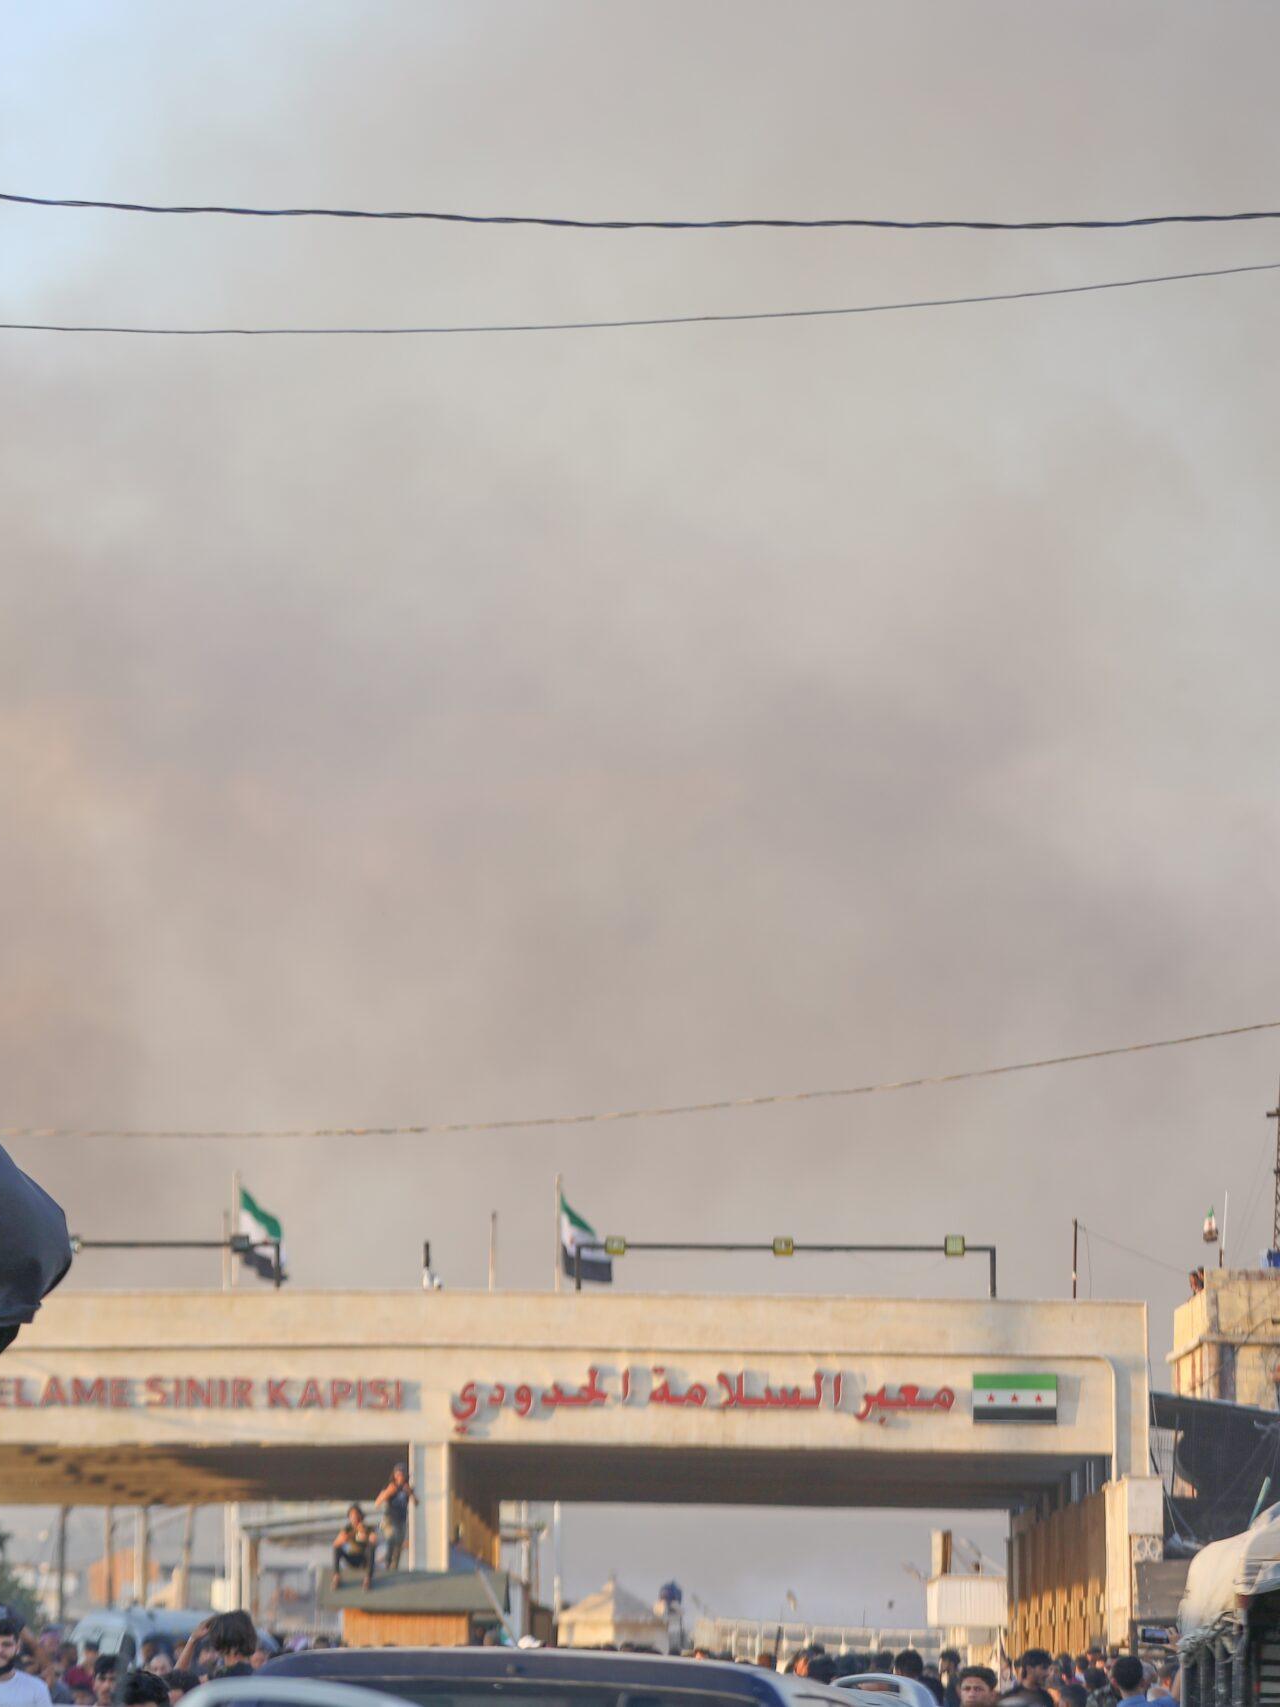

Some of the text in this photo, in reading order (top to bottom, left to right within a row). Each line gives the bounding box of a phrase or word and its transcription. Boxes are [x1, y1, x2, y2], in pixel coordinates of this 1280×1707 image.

[144, 1376, 255, 1408] SINIR
[266, 1377, 403, 1409] KAPISI
[452, 1367, 955, 1434] معبر السلامة الحدودي
